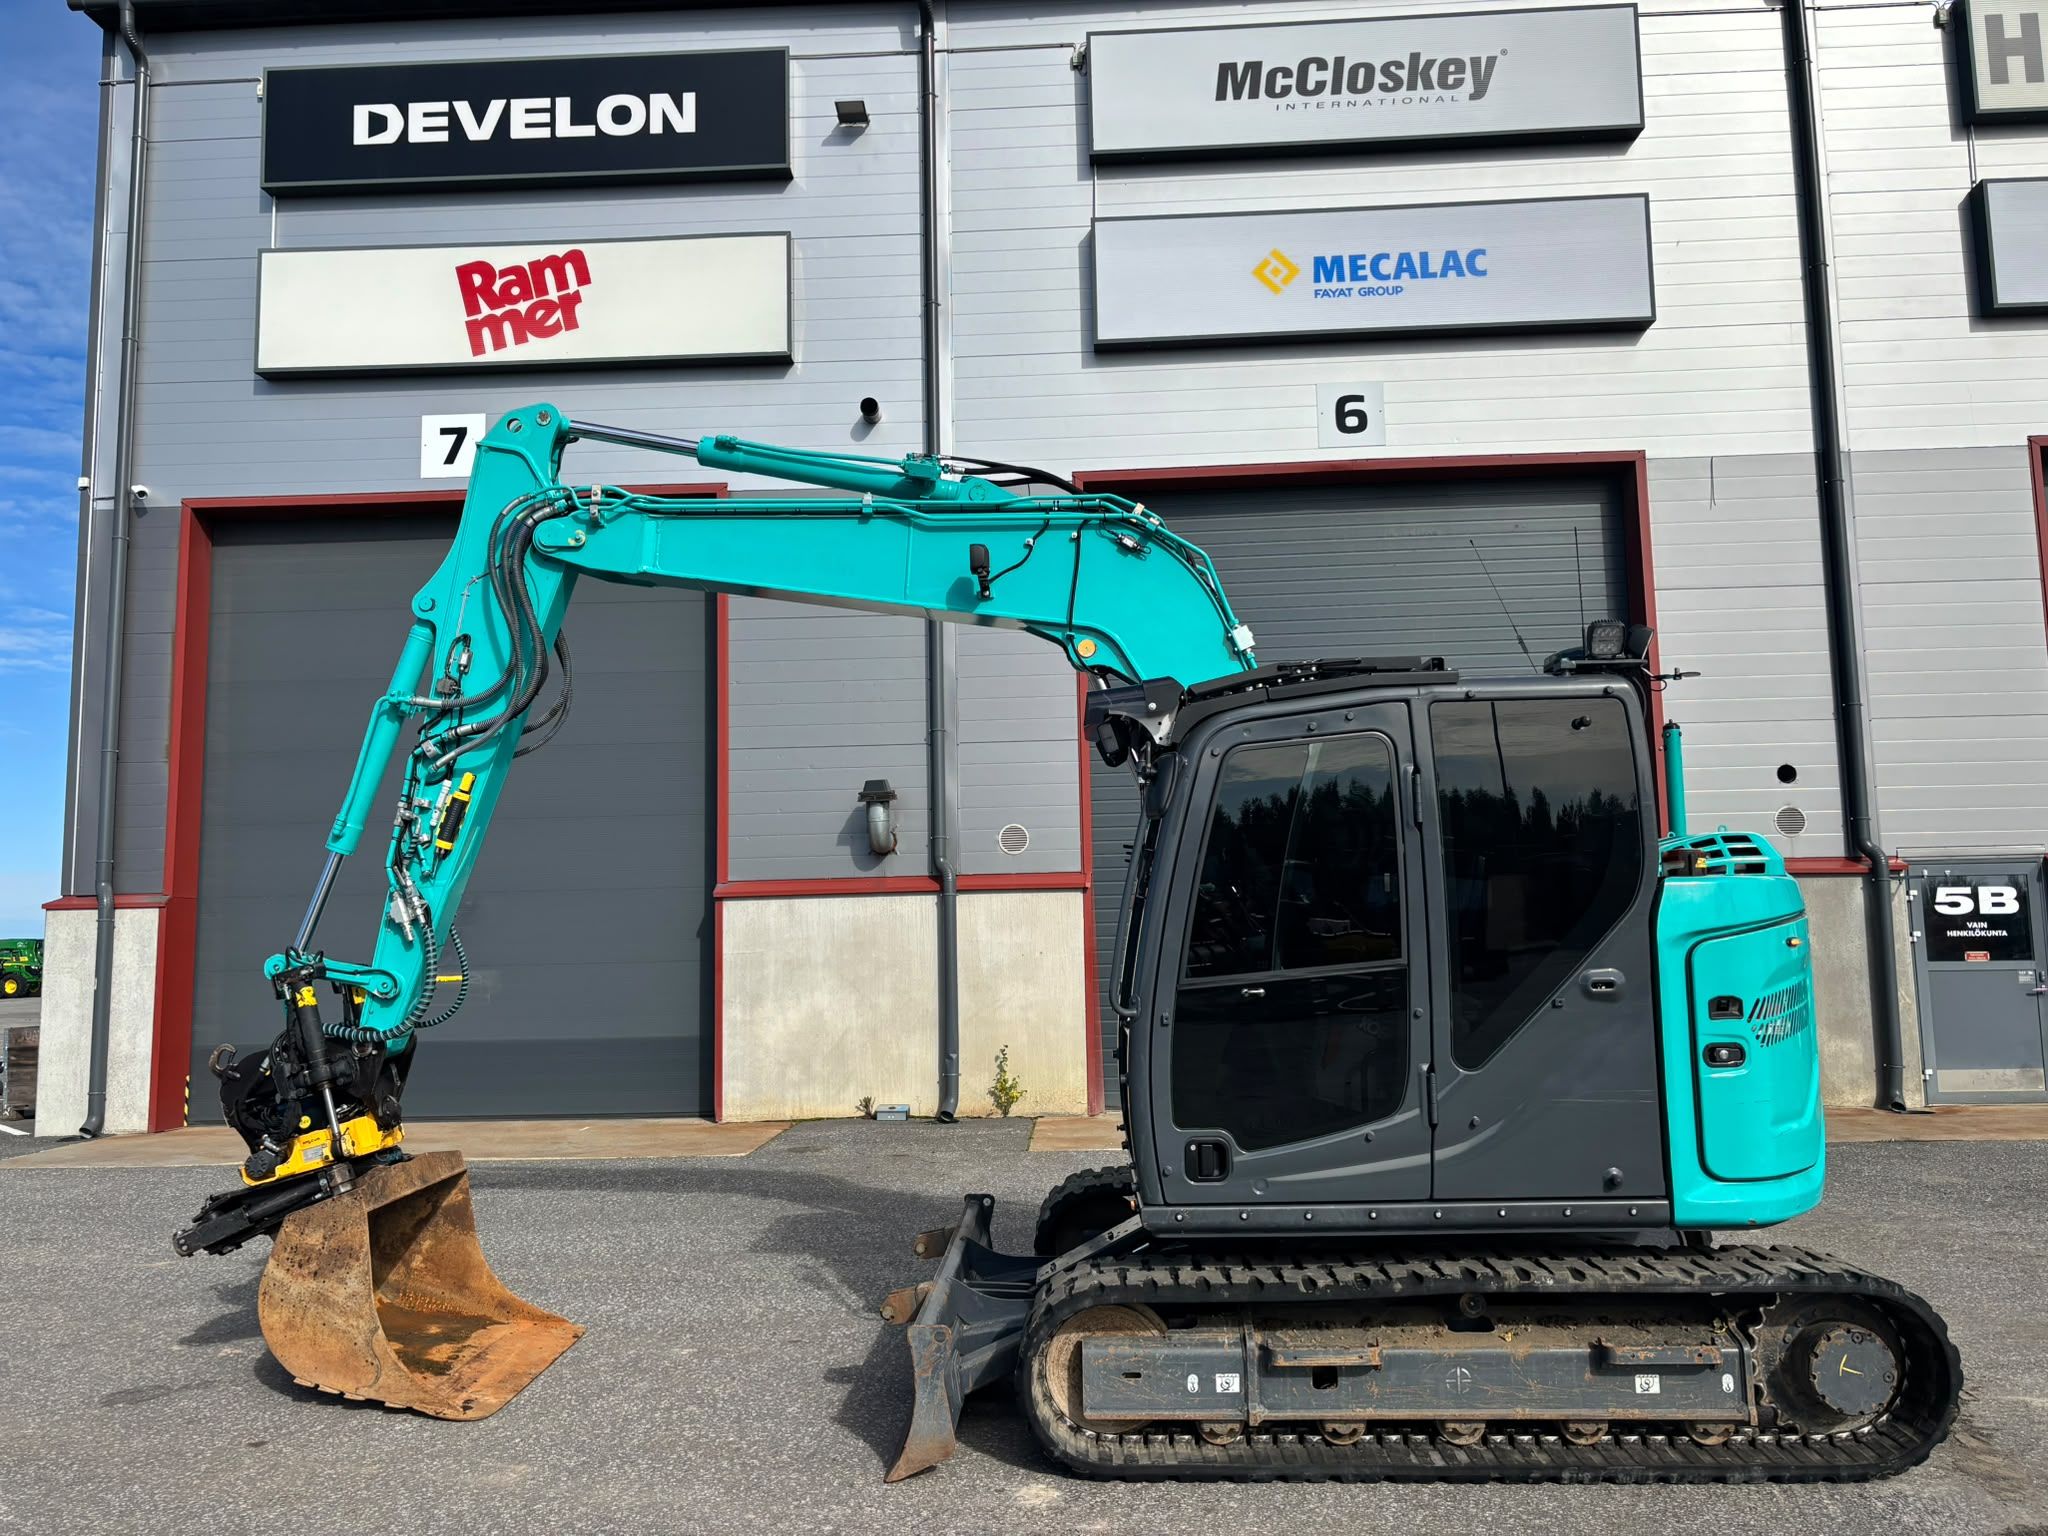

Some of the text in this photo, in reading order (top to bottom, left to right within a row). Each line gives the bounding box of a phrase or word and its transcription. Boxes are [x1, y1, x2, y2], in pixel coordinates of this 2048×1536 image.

[1984, 12, 2045, 85] H
[353, 92, 696, 145] DEVELON
[1276, 95, 1459, 112] INTERNATIONAL
[455, 249, 592, 317] Ram
[1313, 248, 1488, 284] MECALAC
[1314, 285, 1404, 298] FAYAT GROUP
[465, 289, 583, 357] mer
[1335, 394, 1369, 434] 6
[440, 426, 468, 465] 7
[1934, 886, 2020, 915] 5B
[1946, 928, 2008, 937] HENKILÖKUNTA
[1966, 921, 1988, 929] VAIN
